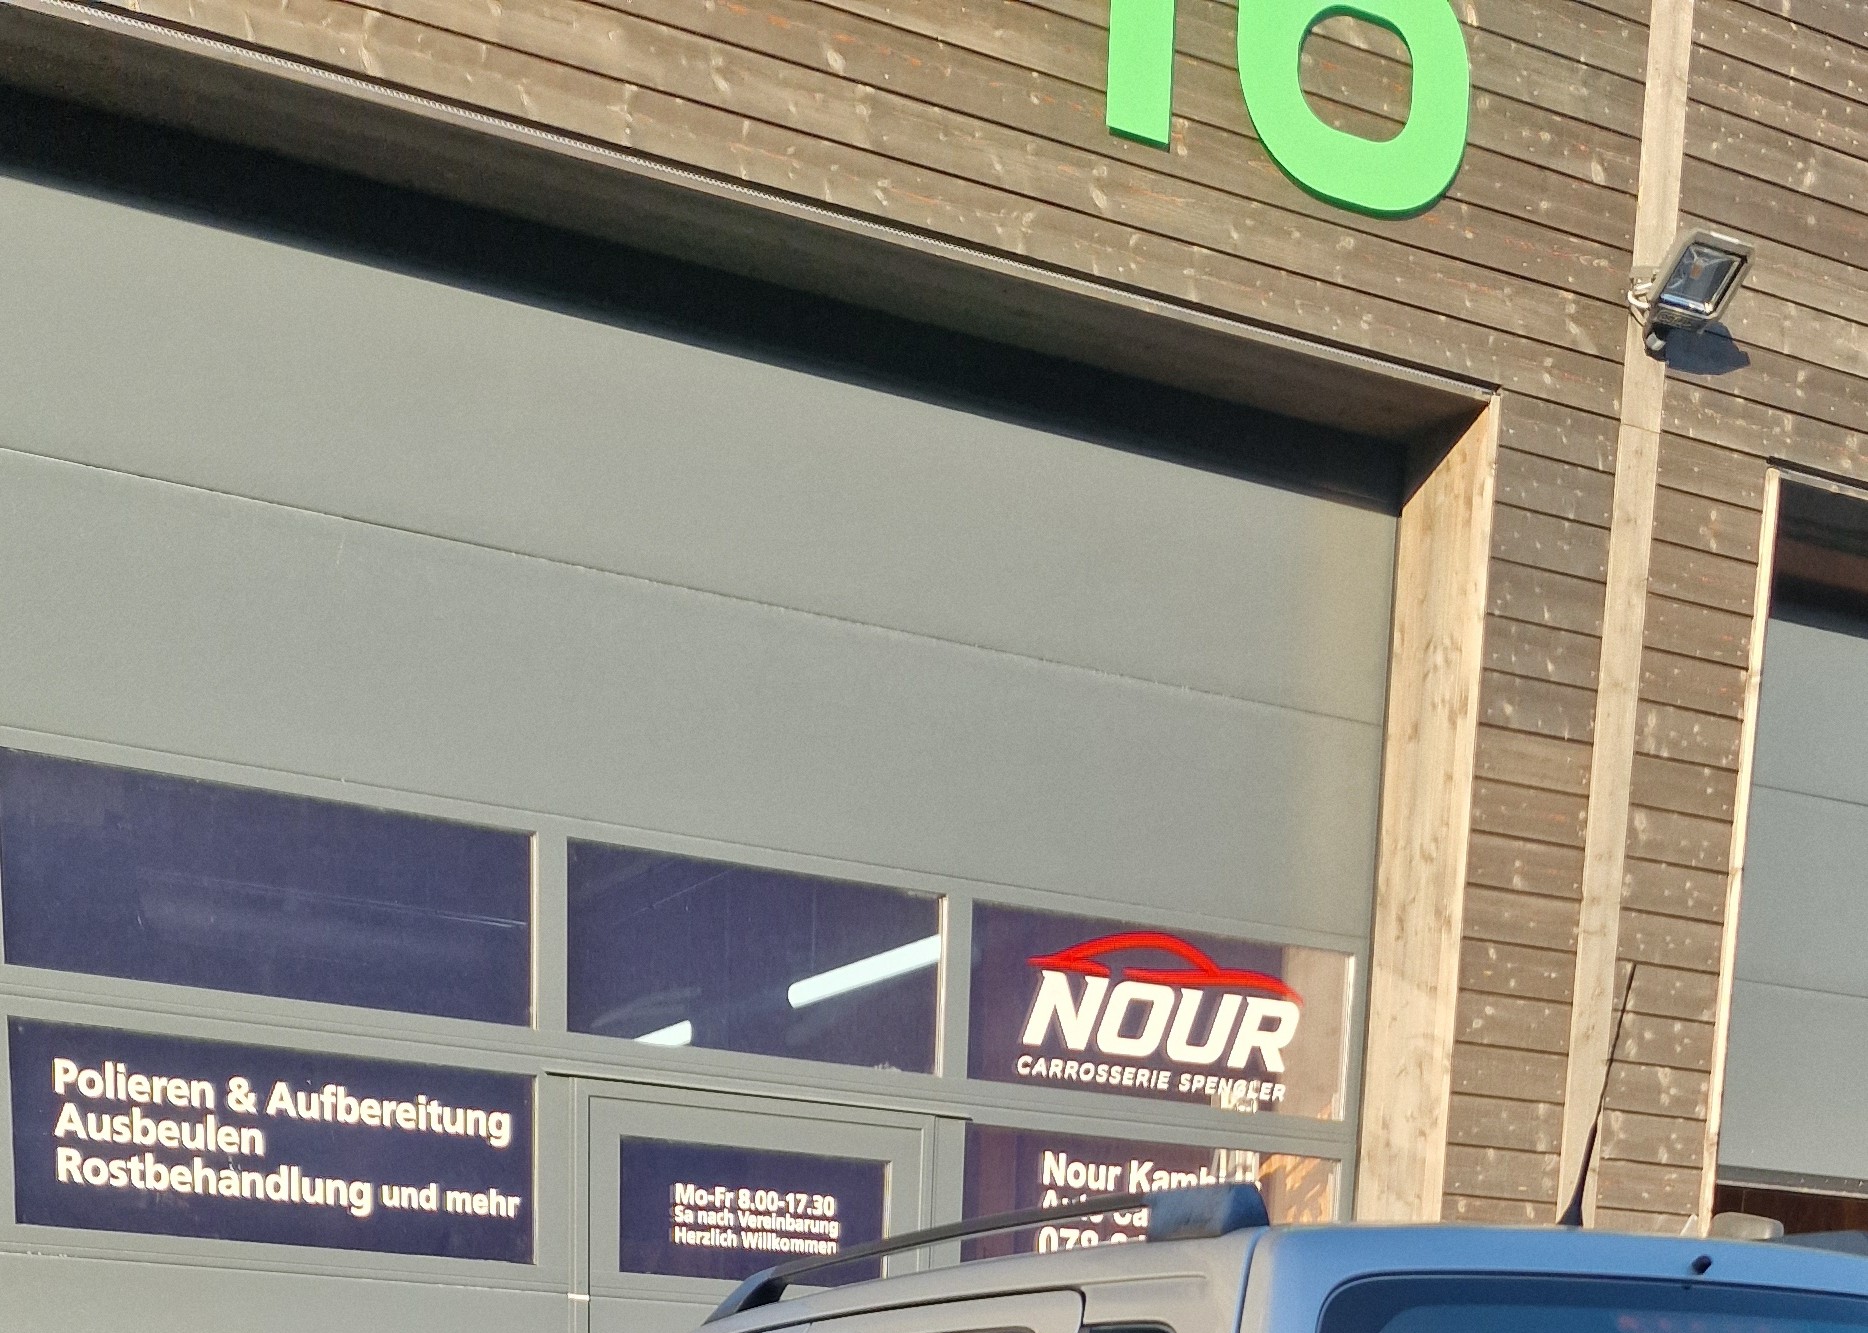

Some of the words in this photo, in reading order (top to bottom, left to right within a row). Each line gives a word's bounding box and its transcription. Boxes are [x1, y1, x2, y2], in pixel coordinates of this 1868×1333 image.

[1022, 970, 1300, 1073] NOUR
[1016, 1055, 1171, 1090] CARROSSERIE
[1178, 1072, 1286, 1102] SPENGLER
[52, 1057, 215, 1109] Polieren
[227, 1075, 257, 1113] &
[266, 1080, 512, 1148] Aufbereitung
[54, 1102, 265, 1157] Ausbeulen
[55, 1146, 374, 1217] Rostbehandlung
[381, 1182, 437, 1212] und
[444, 1187, 521, 1219] mehr
[1042, 1150, 1122, 1191] Nour
[674, 1182, 735, 1207] Mo-Fr
[738, 1188, 836, 1217] 8.00-17.30
[674, 1205, 693, 1225] Sa
[697, 1208, 734, 1227] nach
[738, 1210, 840, 1238] Vereinbarung
[674, 1226, 738, 1248] Herzlich
[741, 1230, 837, 1255] Willkommen
